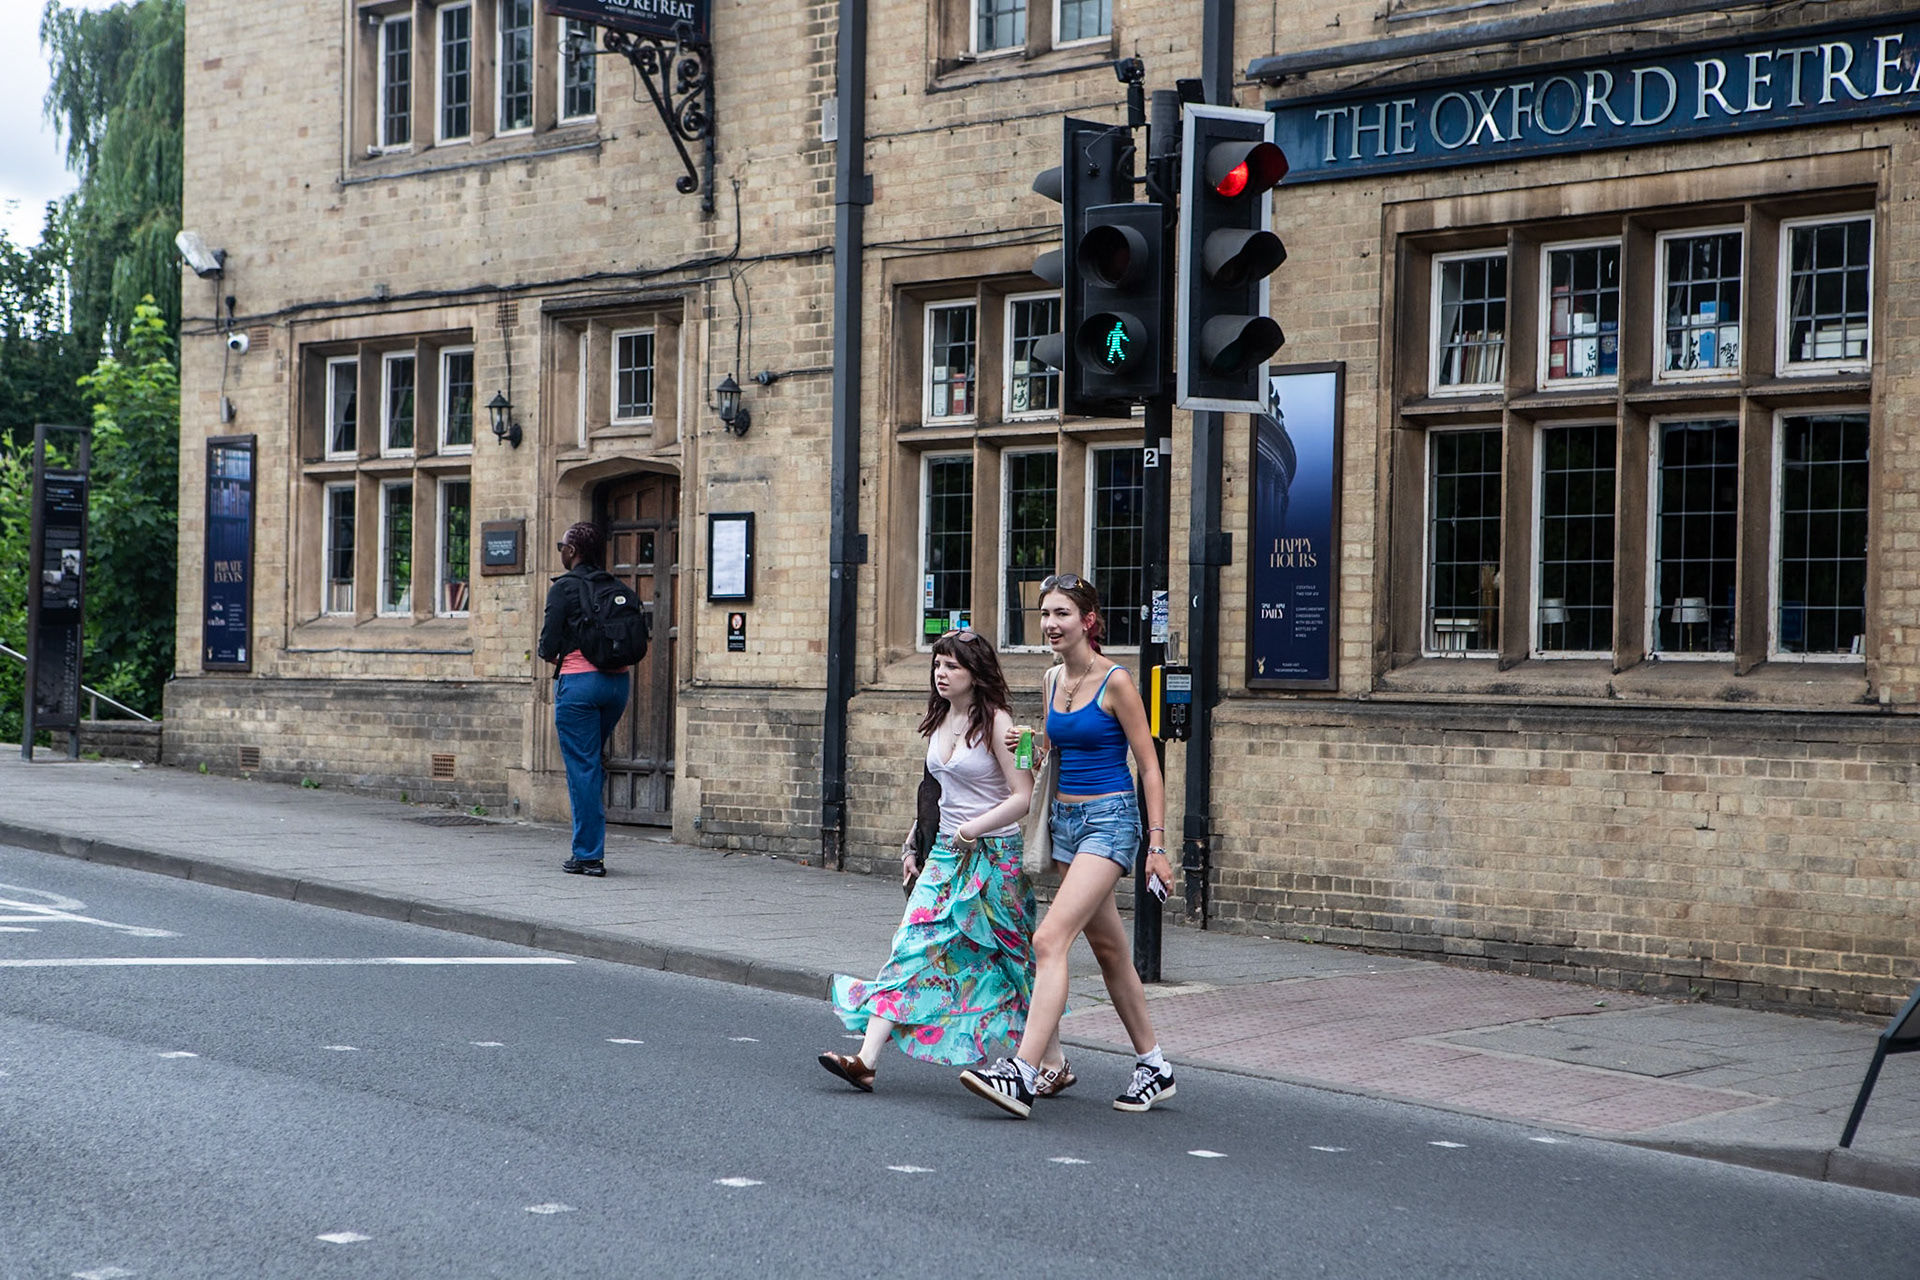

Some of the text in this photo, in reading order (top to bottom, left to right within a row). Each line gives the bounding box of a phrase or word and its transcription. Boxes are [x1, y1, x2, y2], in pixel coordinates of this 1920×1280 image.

[633, 0, 695, 19] RETREAT
[1315, 98, 1416, 162] THE
[1430, 66, 1677, 150] OXFORD
[1145, 450, 1155, 465] 2
[1274, 538, 1311, 553] HAPPY
[214, 561, 242, 572] PRIVATE
[1270, 553, 1317, 568] HOURS
[214, 572, 243, 583] EVENTS
[1261, 609, 1283, 619] DAILY
